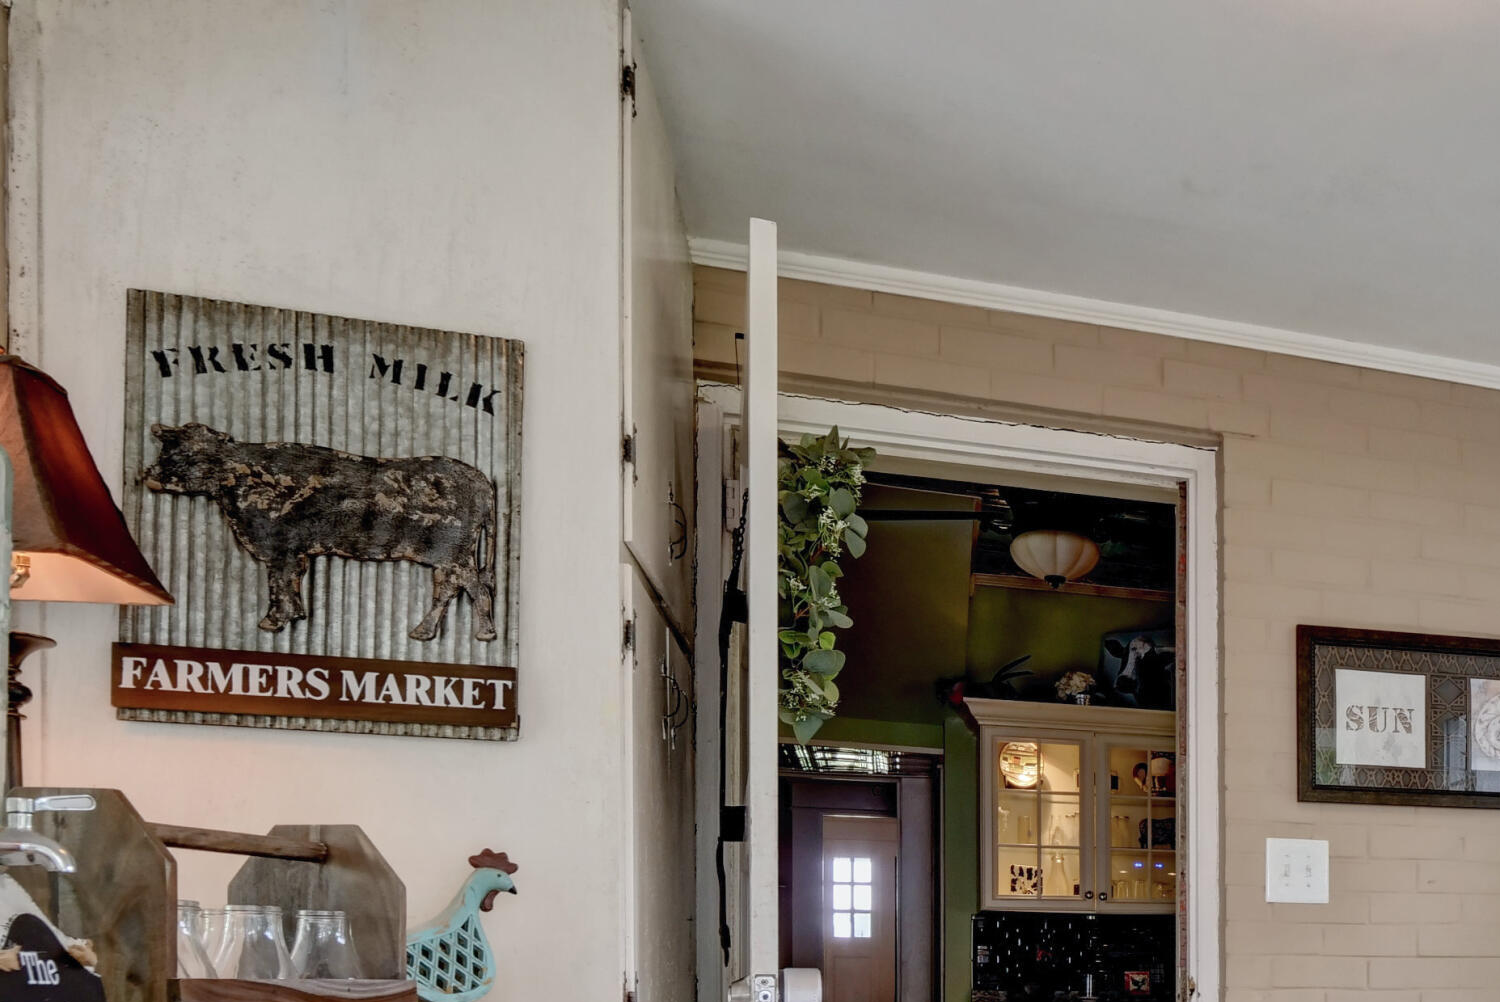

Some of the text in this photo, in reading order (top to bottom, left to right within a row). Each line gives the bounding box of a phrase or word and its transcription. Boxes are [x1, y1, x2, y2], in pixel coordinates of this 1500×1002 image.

[151, 343, 502, 417] FRESH MILK
[118, 656, 513, 710] FARMERS MARKET
[1345, 704, 1416, 734] SUN
[19, 951, 60, 985] The
